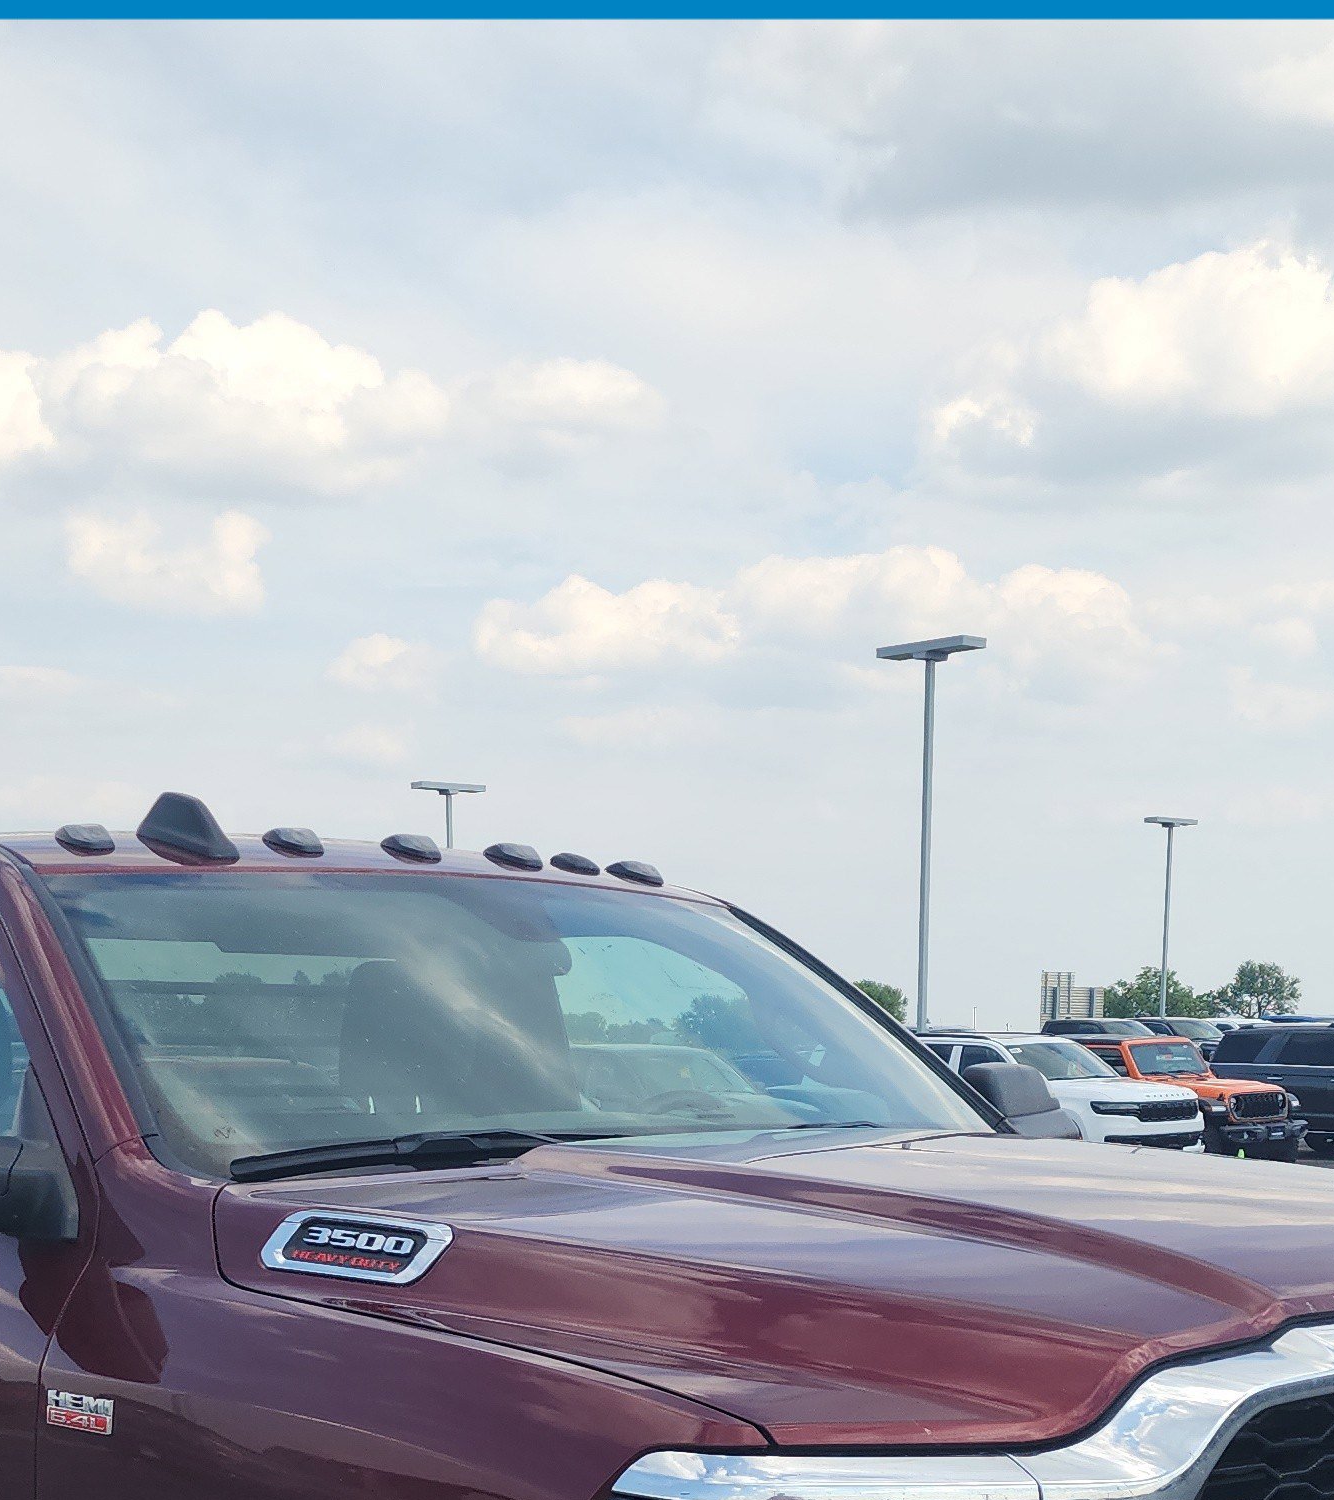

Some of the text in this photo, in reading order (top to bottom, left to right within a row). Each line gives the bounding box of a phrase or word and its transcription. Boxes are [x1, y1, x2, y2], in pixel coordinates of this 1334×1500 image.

[301, 1226, 415, 1255] 3500
[291, 1249, 402, 1272] HEAVY DUTY
[47, 1389, 114, 1417] HEMI
[50, 1409, 106, 1431] 6.4L
